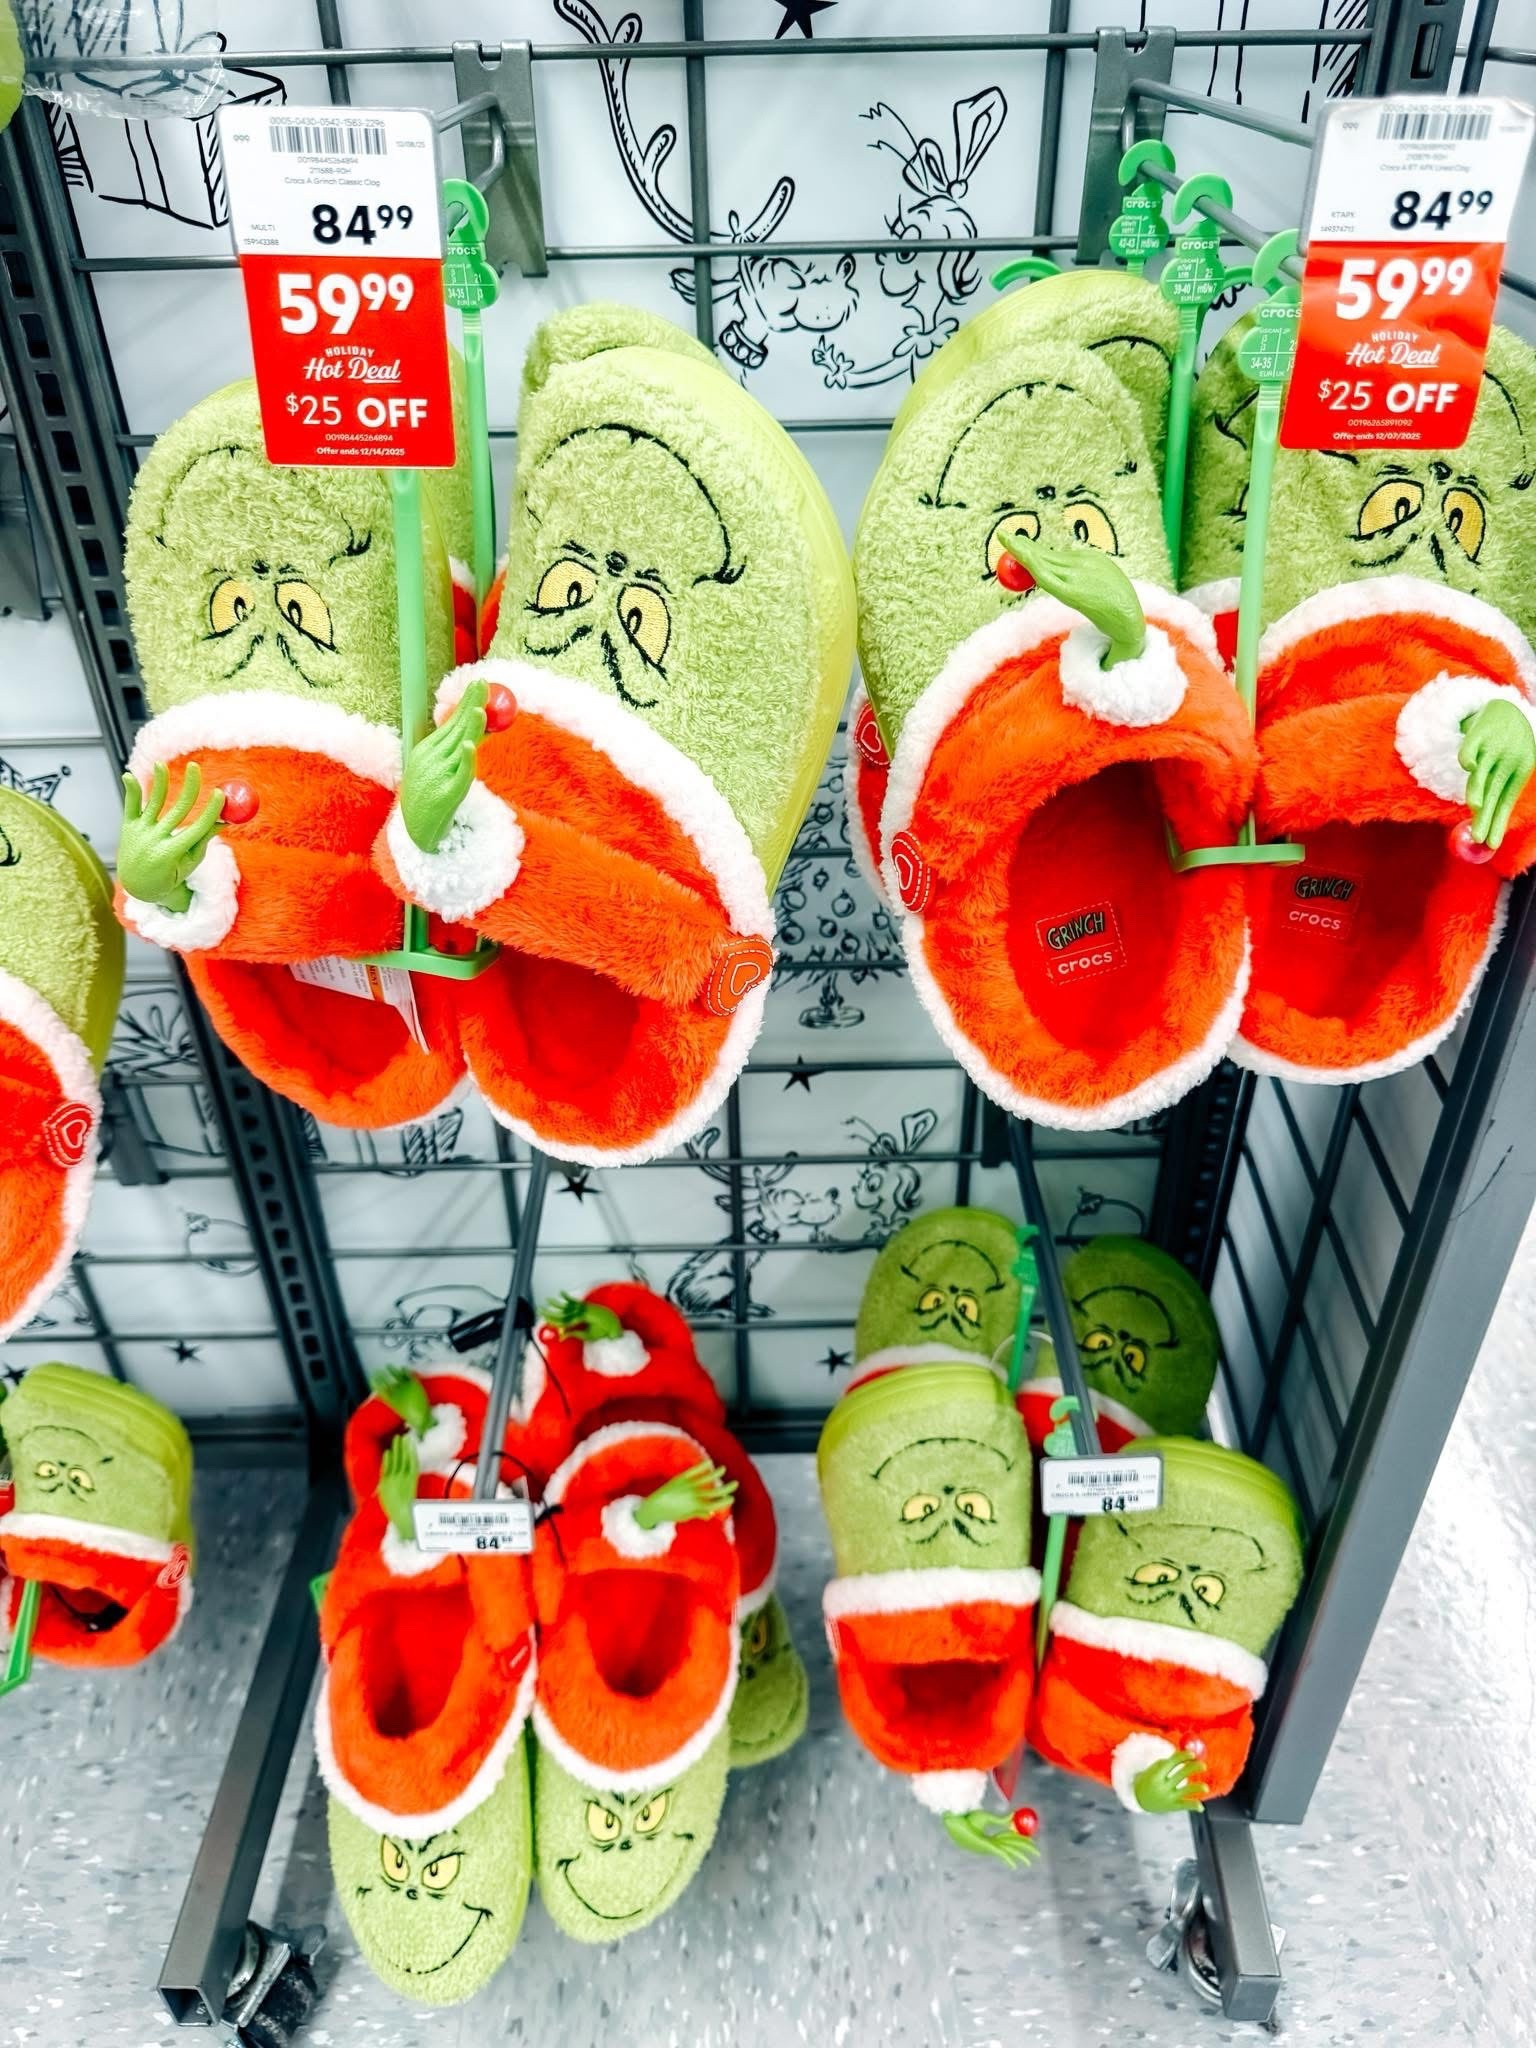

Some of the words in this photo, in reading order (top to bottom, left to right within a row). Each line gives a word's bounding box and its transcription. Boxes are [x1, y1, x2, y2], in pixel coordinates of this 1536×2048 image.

[1126, 200, 1157, 208] crocs
[1181, 241, 1214, 250] crocs
[1261, 308, 1302, 318] crocs
[1371, 330, 1419, 343] HOLIDAY
[325, 346, 375, 358] HOLIDAY
[1345, 342, 1385, 367] Hot
[1388, 341, 1442, 369] Deal
[303, 357, 345, 381] Hot
[347, 357, 402, 384] Deal
[1317, 378, 1373, 411] $25
[1385, 383, 1460, 413] OFF
[286, 392, 342, 425] $25
[356, 397, 428, 428] OFF
[1347, 418, 1413, 427] 00196265891092
[325, 433, 393, 442] 00198445264894
[1333, 431, 1356, 440] Offer
[1356, 432, 1374, 440] ends
[1375, 431, 1421, 440] 12/07/2025
[316, 446, 339, 455] Offer
[340, 447, 359, 455] ends
[360, 446, 405, 456] 12/14/2025
[1294, 876, 1354, 900] GRINCH
[1289, 911, 1342, 930] crocs
[1046, 911, 1105, 951] GRINCH
[1058, 951, 1113, 974] crocs
